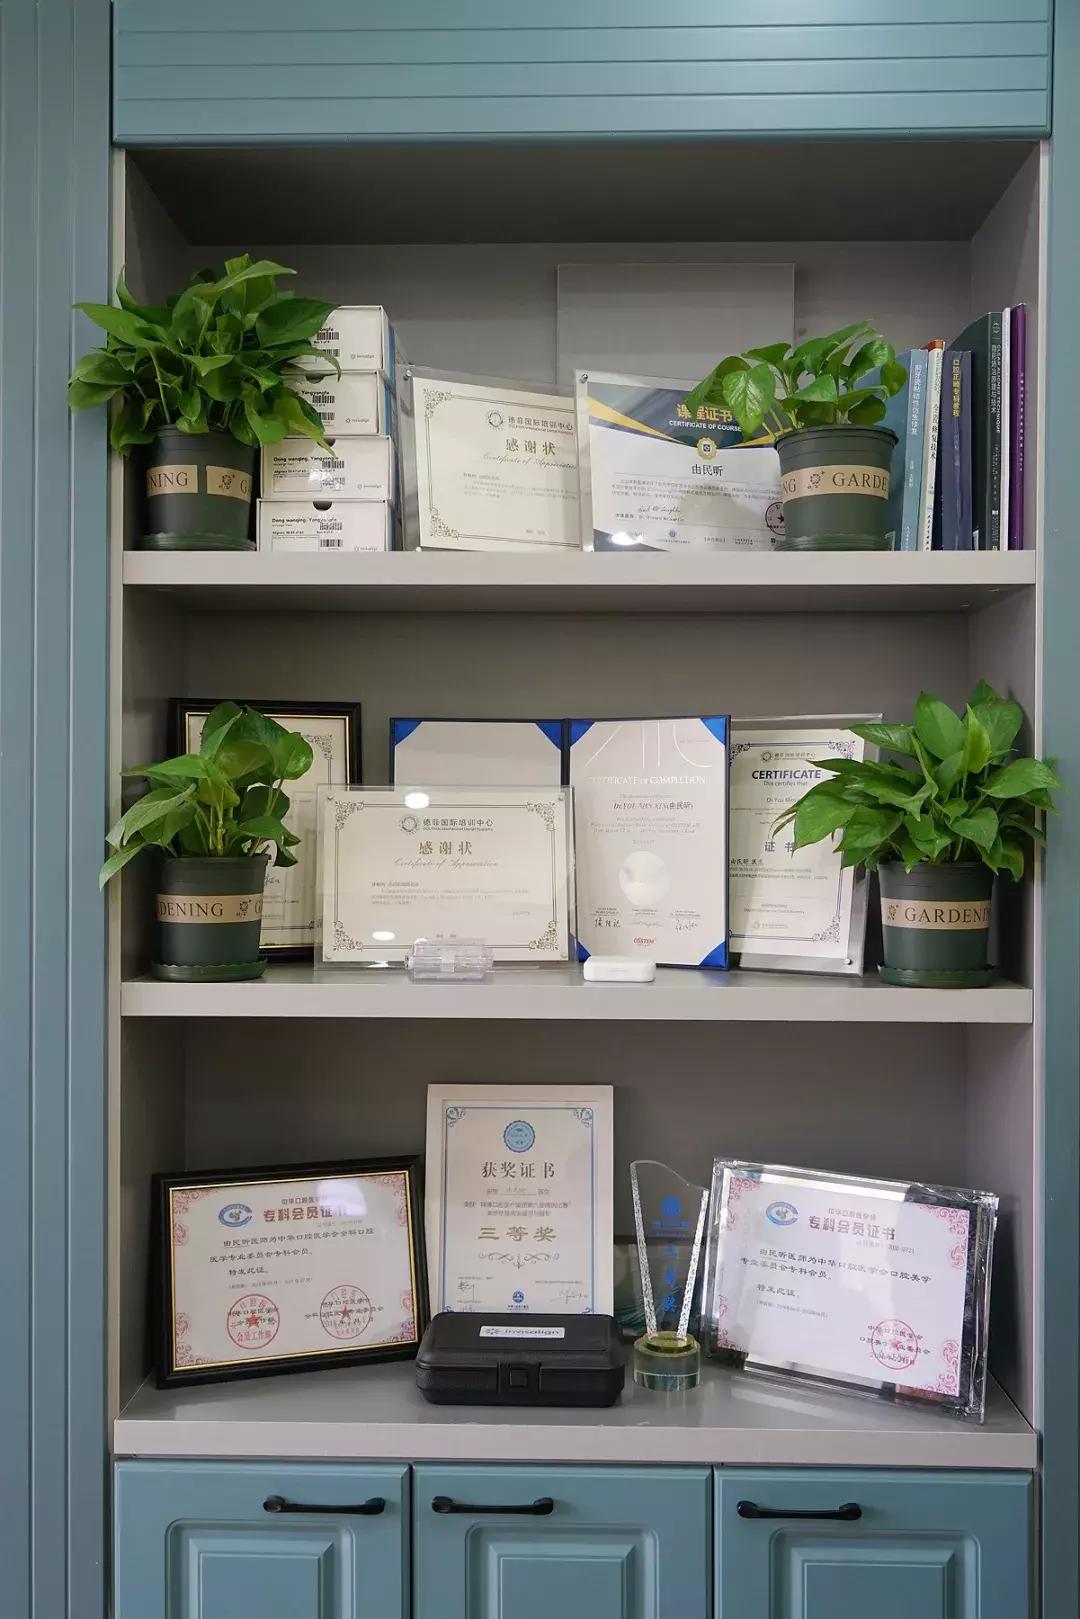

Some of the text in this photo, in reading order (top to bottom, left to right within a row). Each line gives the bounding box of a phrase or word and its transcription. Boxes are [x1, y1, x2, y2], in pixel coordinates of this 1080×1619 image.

[669, 420, 706, 429] CERTIFICATE
[505, 437, 556, 456] 感谢状
[752, 769, 821, 780] CERTIFICATE
[423, 818, 494, 827] 德菲国际培训中心
[419, 840, 473, 855] 感谢状
[480, 1161, 556, 1179] 获奖证书
[263, 1205, 346, 1223] 专科会员证
[477, 1226, 557, 1242] 三等奖
[807, 1214, 896, 1241] 专科会员证书
